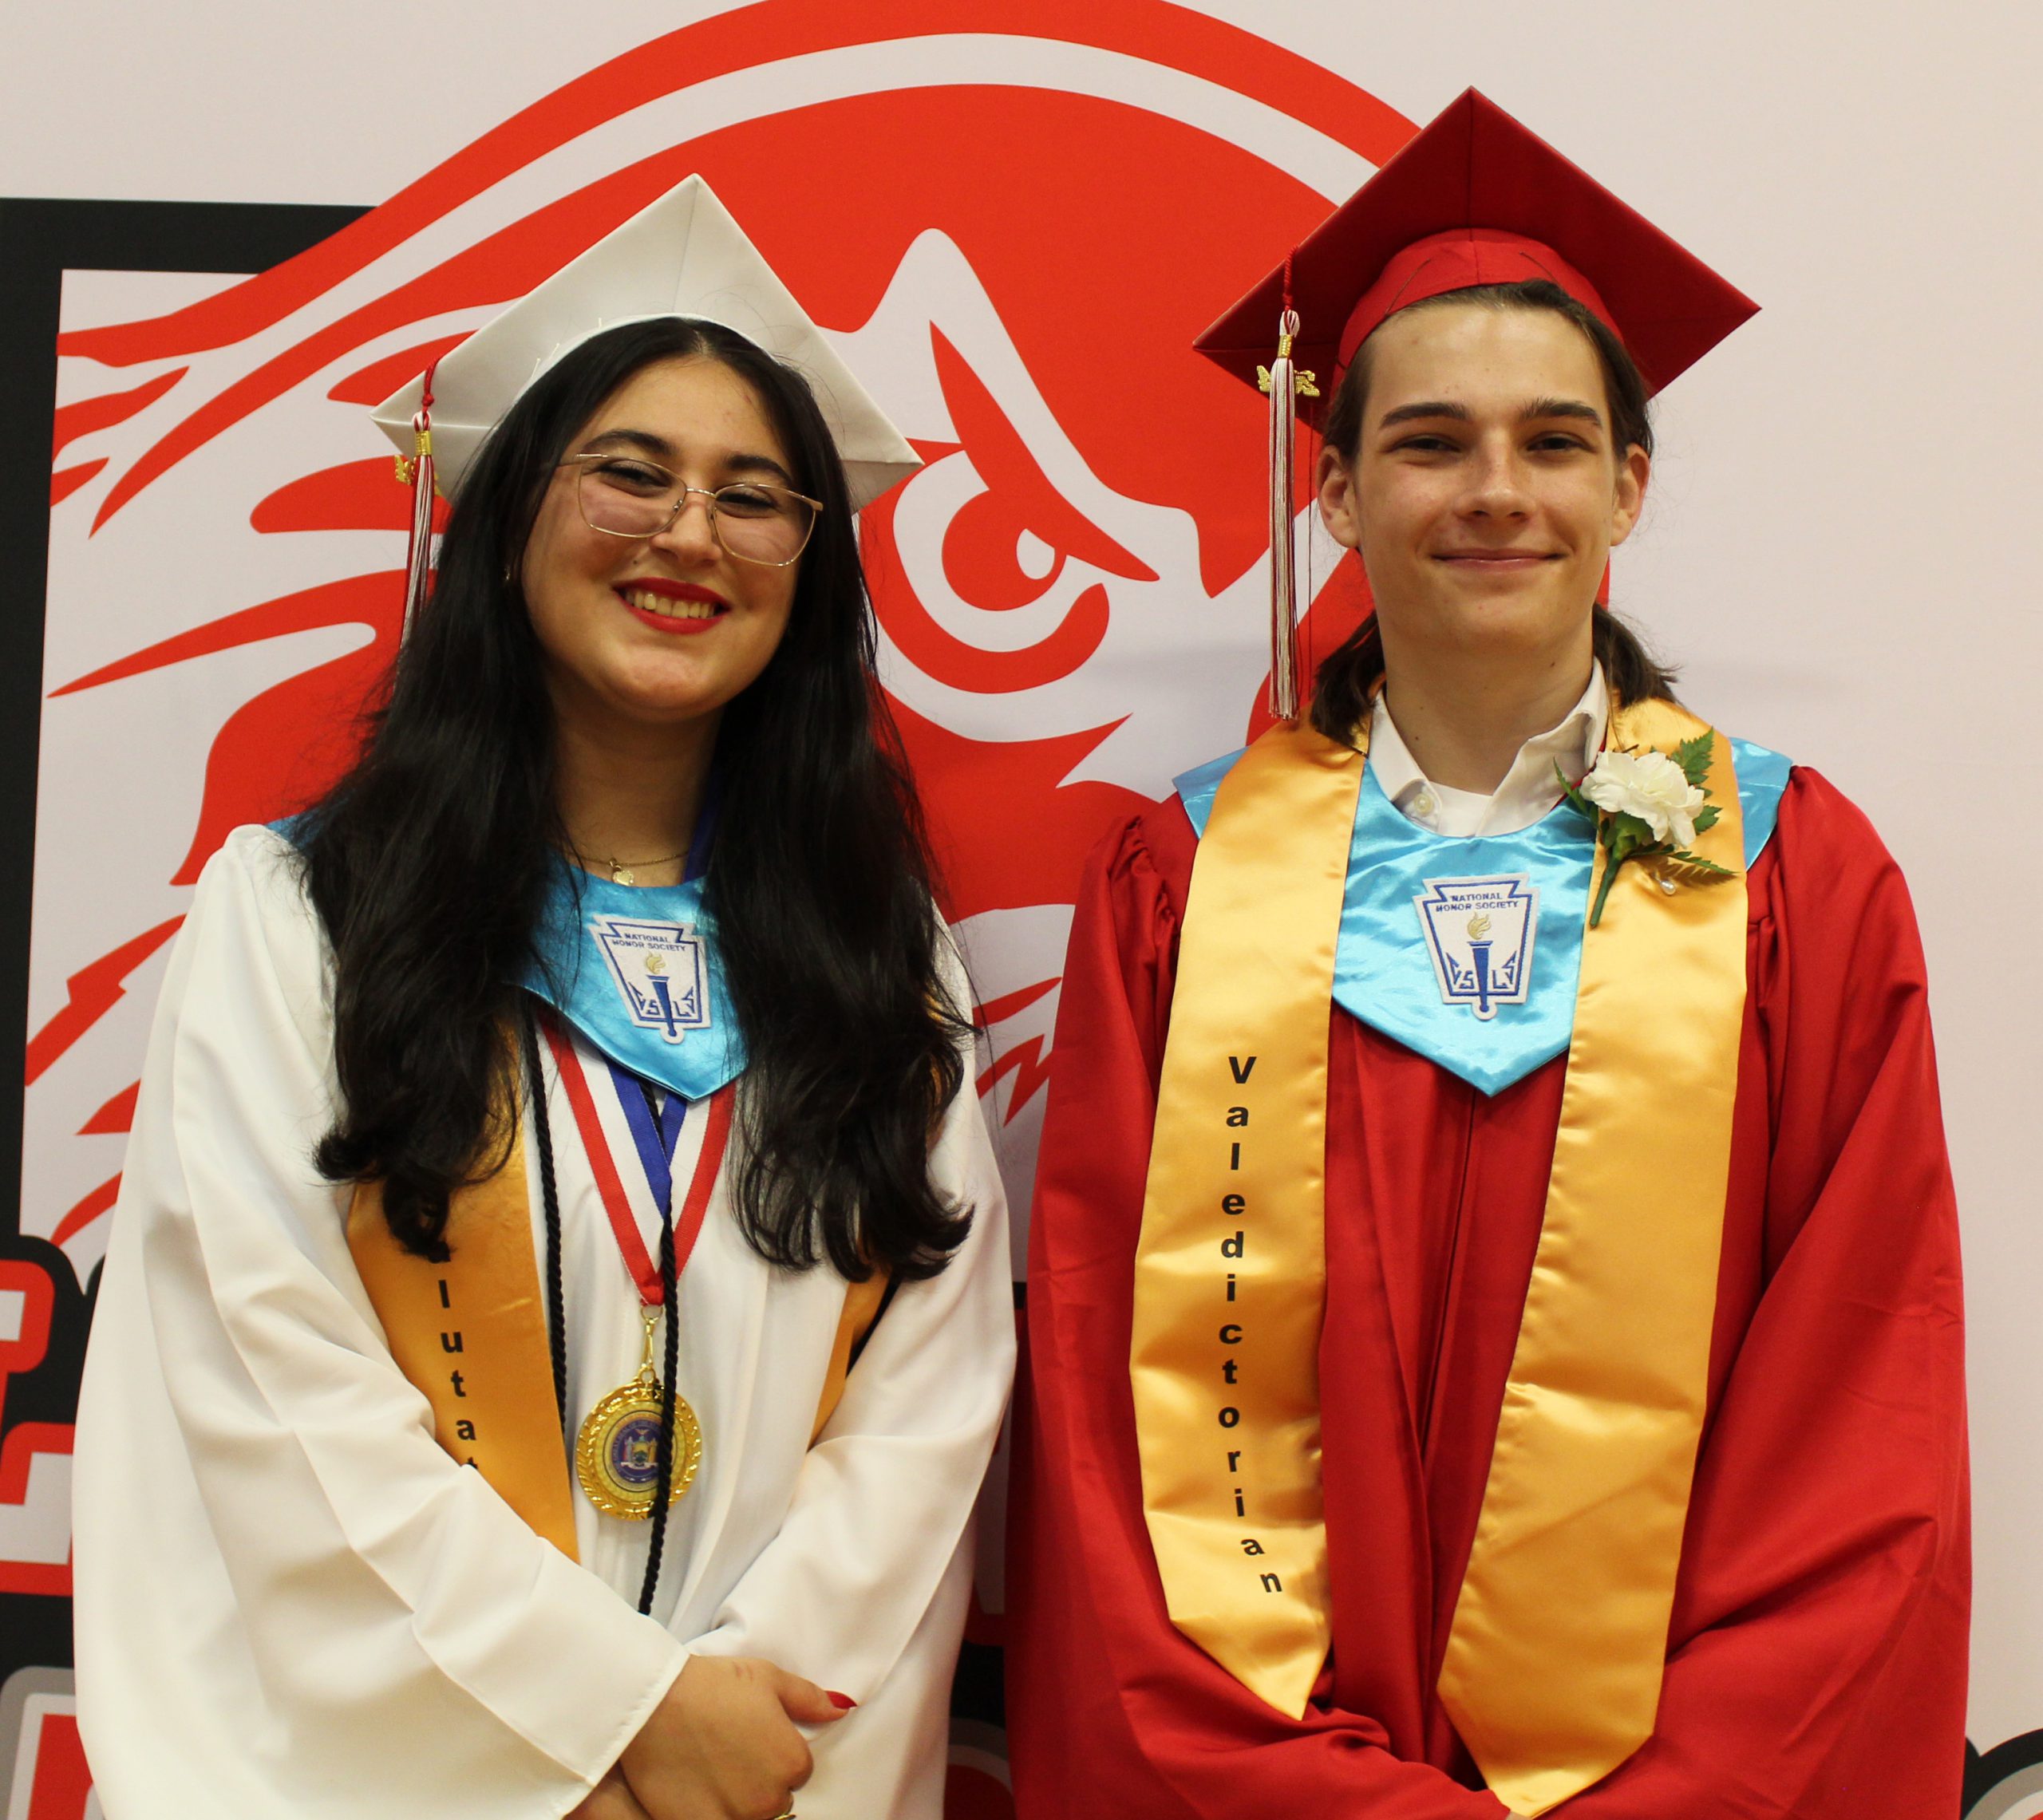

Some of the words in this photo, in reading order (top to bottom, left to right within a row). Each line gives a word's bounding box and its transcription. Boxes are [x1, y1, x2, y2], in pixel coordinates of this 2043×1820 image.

[1450, 893, 1503, 902] NATIONAL
[1436, 903, 1472, 912] HONOR
[1476, 901, 1518, 910] SOCIETY
[624, 933, 668, 942] NATIONAL
[647, 943, 686, 952] SOCIETY
[1219, 1056, 1282, 1593] Valedictorian
